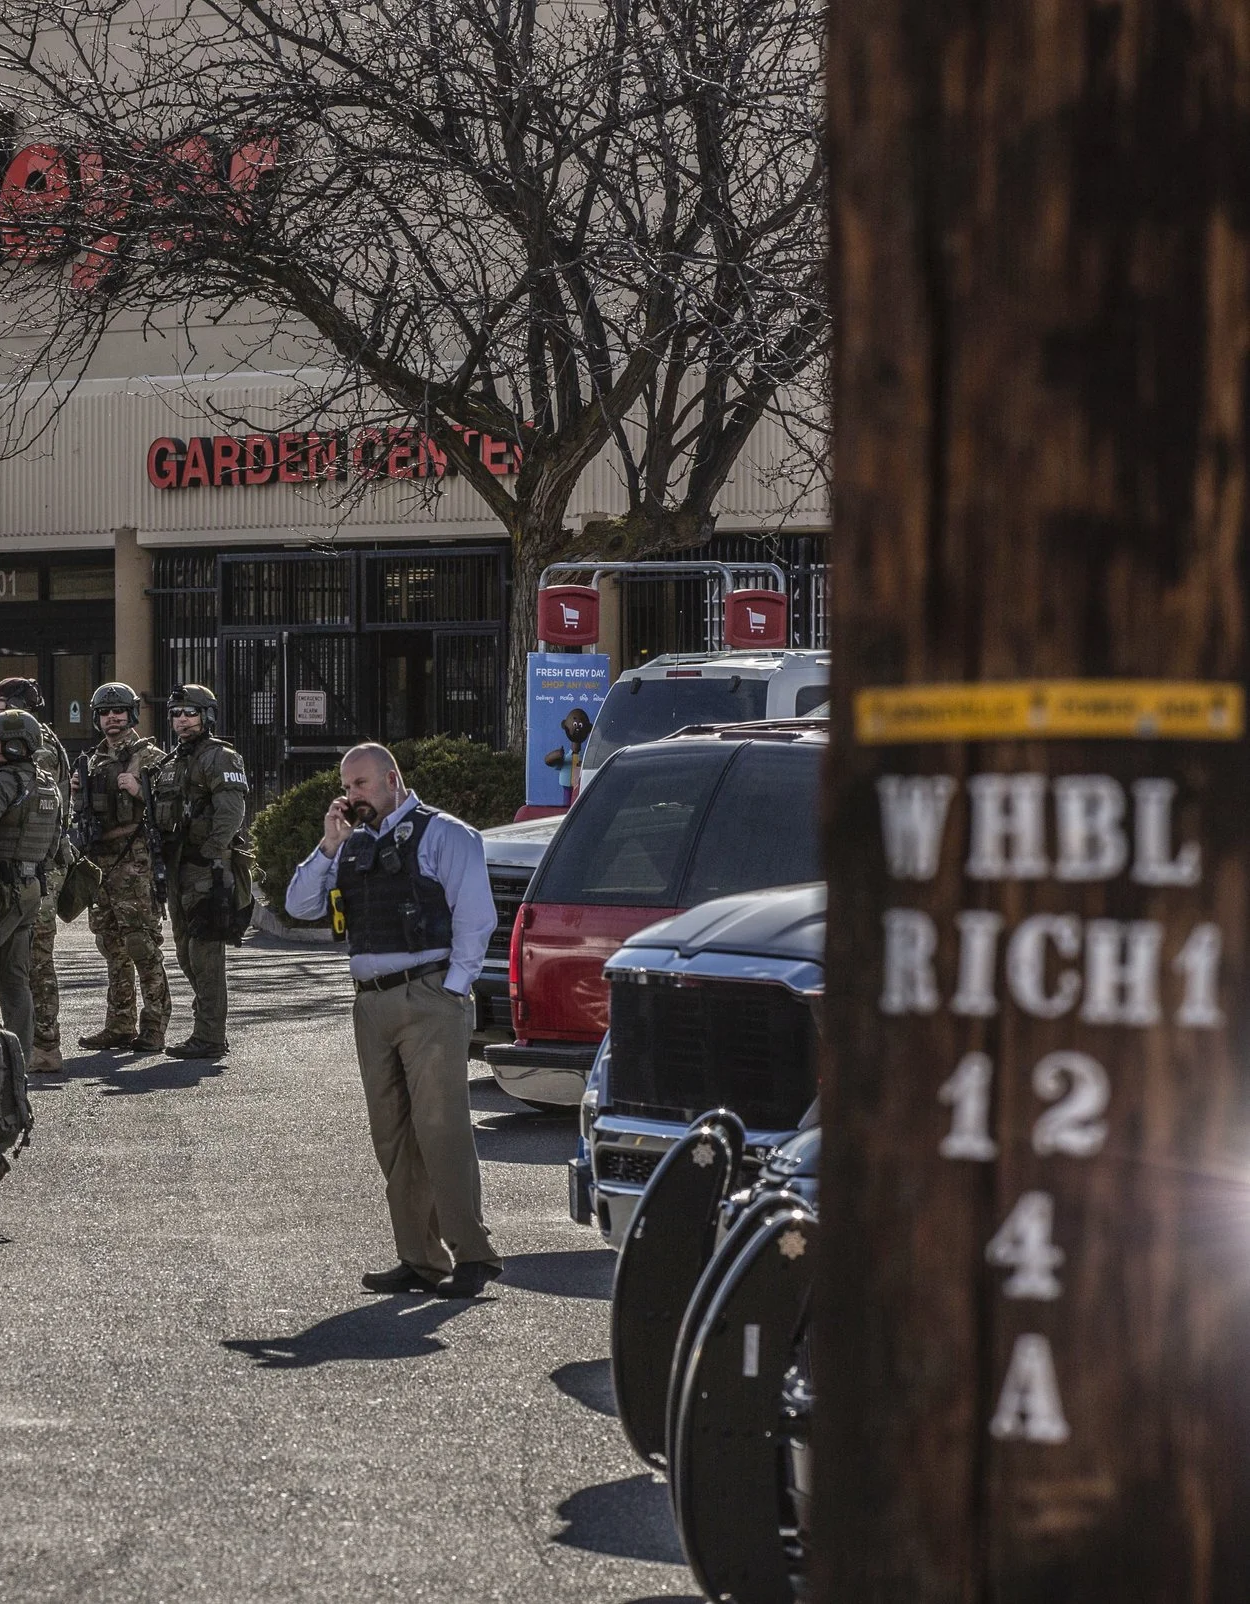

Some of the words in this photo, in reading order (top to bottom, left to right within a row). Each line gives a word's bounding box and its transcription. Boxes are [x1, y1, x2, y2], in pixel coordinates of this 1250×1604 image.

[147, 431, 340, 489] GARDEN
[352, 422, 535, 480] CENE
[535, 668, 563, 677] FRESH
[565, 668, 590, 678] EVERY
[591, 669, 606, 678] DAY.
[541, 680, 565, 689] SHOP
[535, 694, 554, 704] Delivery
[39, 799, 54, 811] POLICE
[877, 771, 1202, 888] WHBL
[986, 1190, 1066, 1301] 4
[990, 1331, 1069, 1443] A
